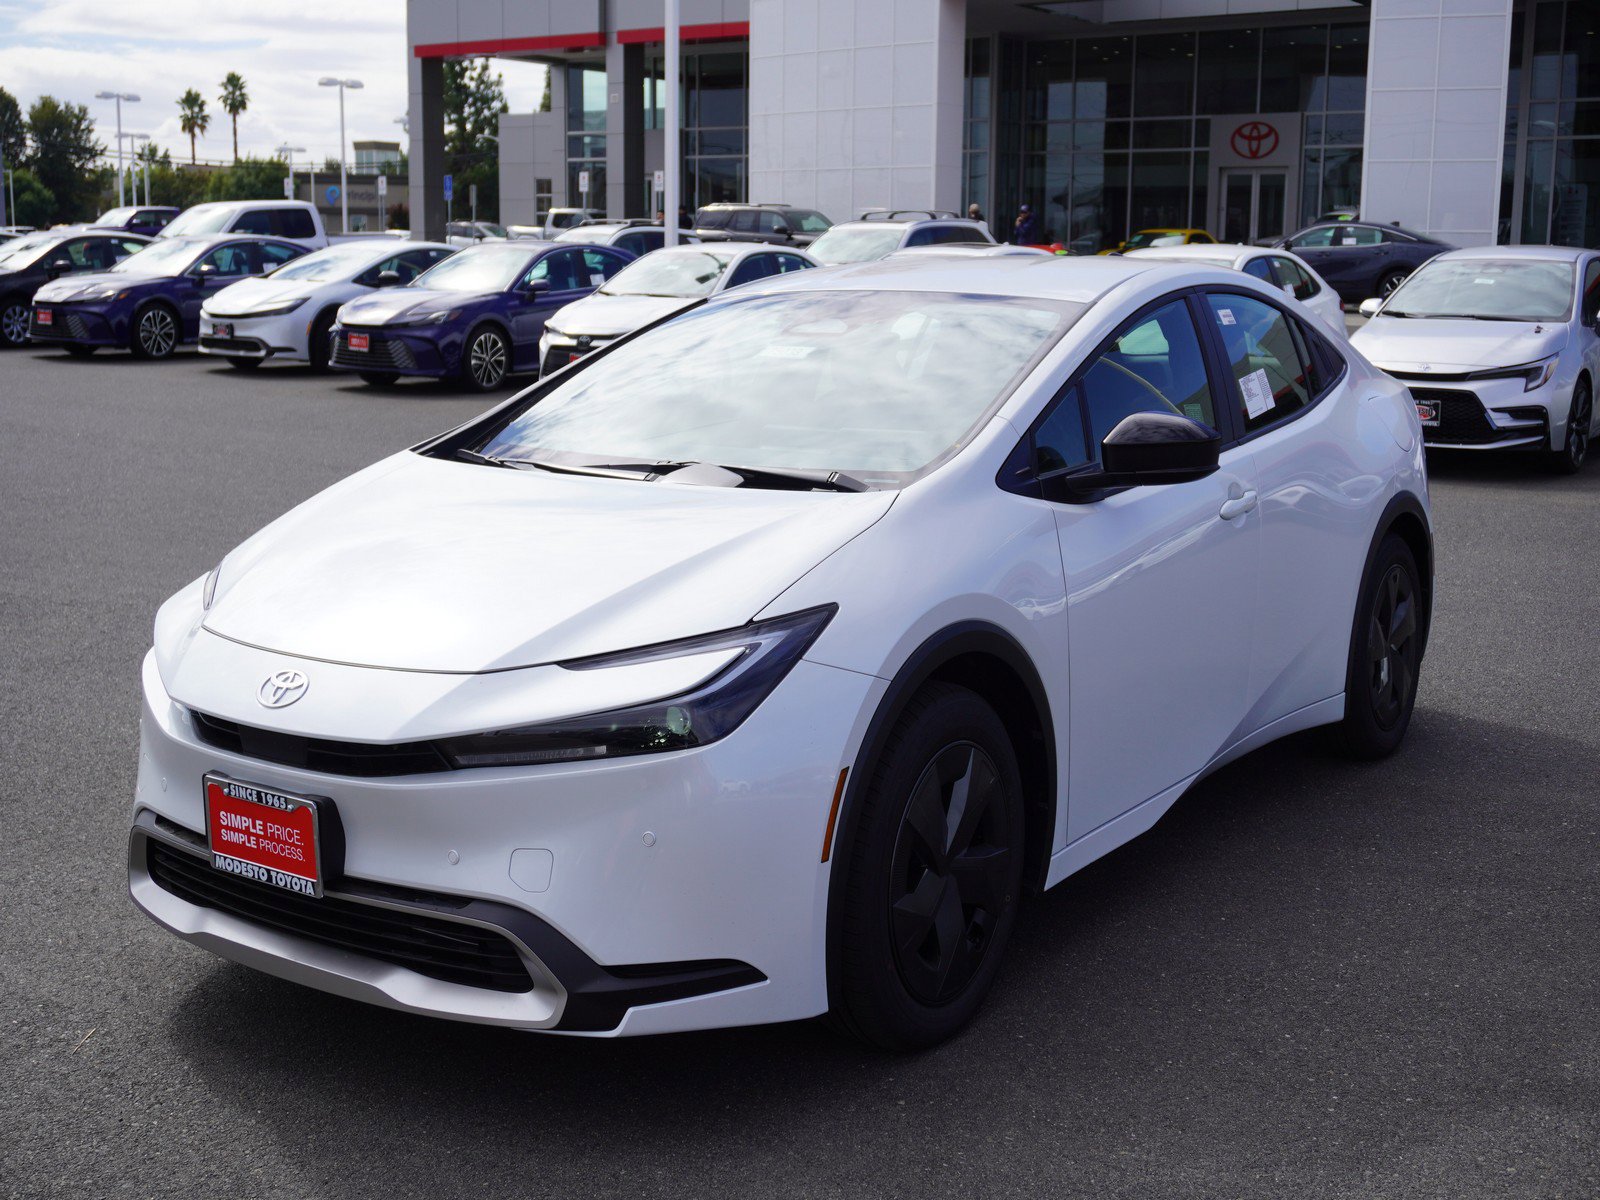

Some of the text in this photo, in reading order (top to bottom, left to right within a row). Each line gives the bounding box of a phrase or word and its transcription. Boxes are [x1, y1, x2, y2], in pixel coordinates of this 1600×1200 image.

[229, 784, 286, 809] SINCE 1965
[219, 810, 305, 846] SIMPLE PRICE.
[221, 828, 306, 862] SIMPLE PROCESS.
[215, 855, 315, 896] MODESTO TOYOTA
